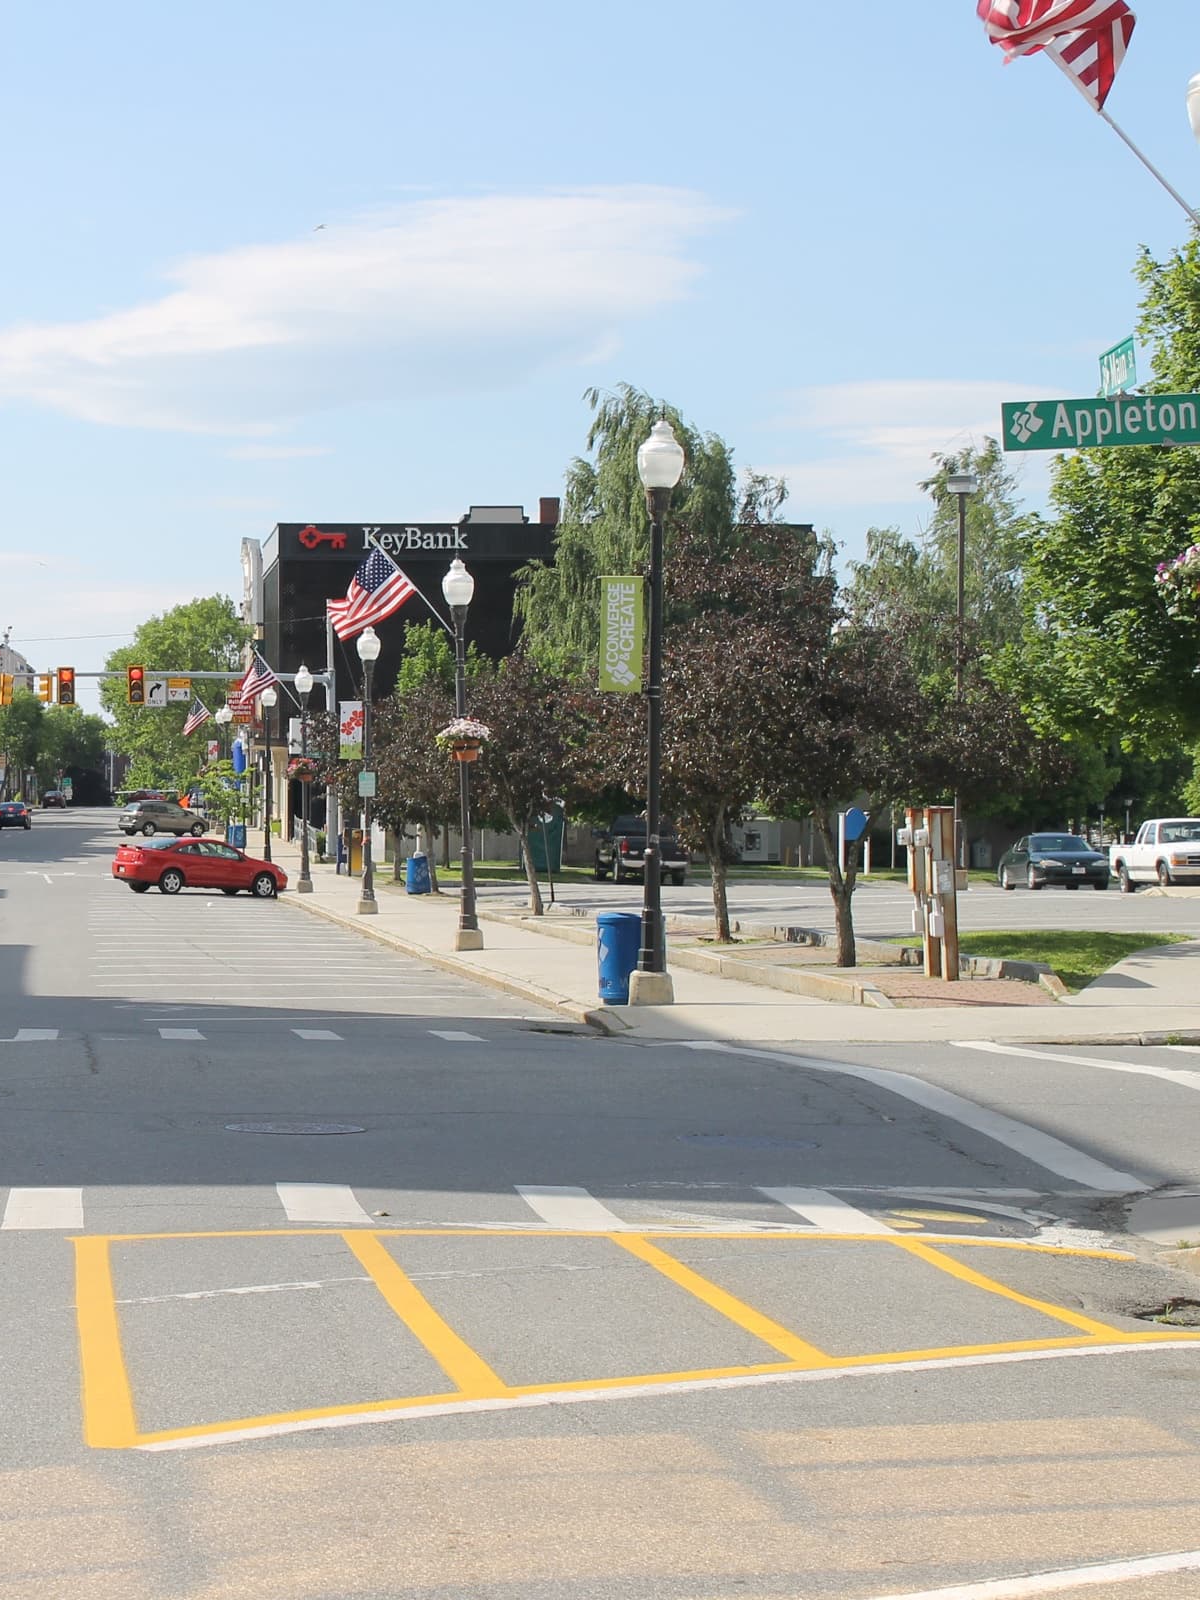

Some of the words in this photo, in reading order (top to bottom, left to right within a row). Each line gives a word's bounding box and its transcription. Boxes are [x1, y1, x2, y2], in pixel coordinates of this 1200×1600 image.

[1109, 348, 1128, 389] Main
[1051, 398, 1197, 446] Appleton
[362, 526, 469, 555] KeyBank
[606, 582, 620, 663] CONVERGE
[620, 583, 636, 652] CREATE
